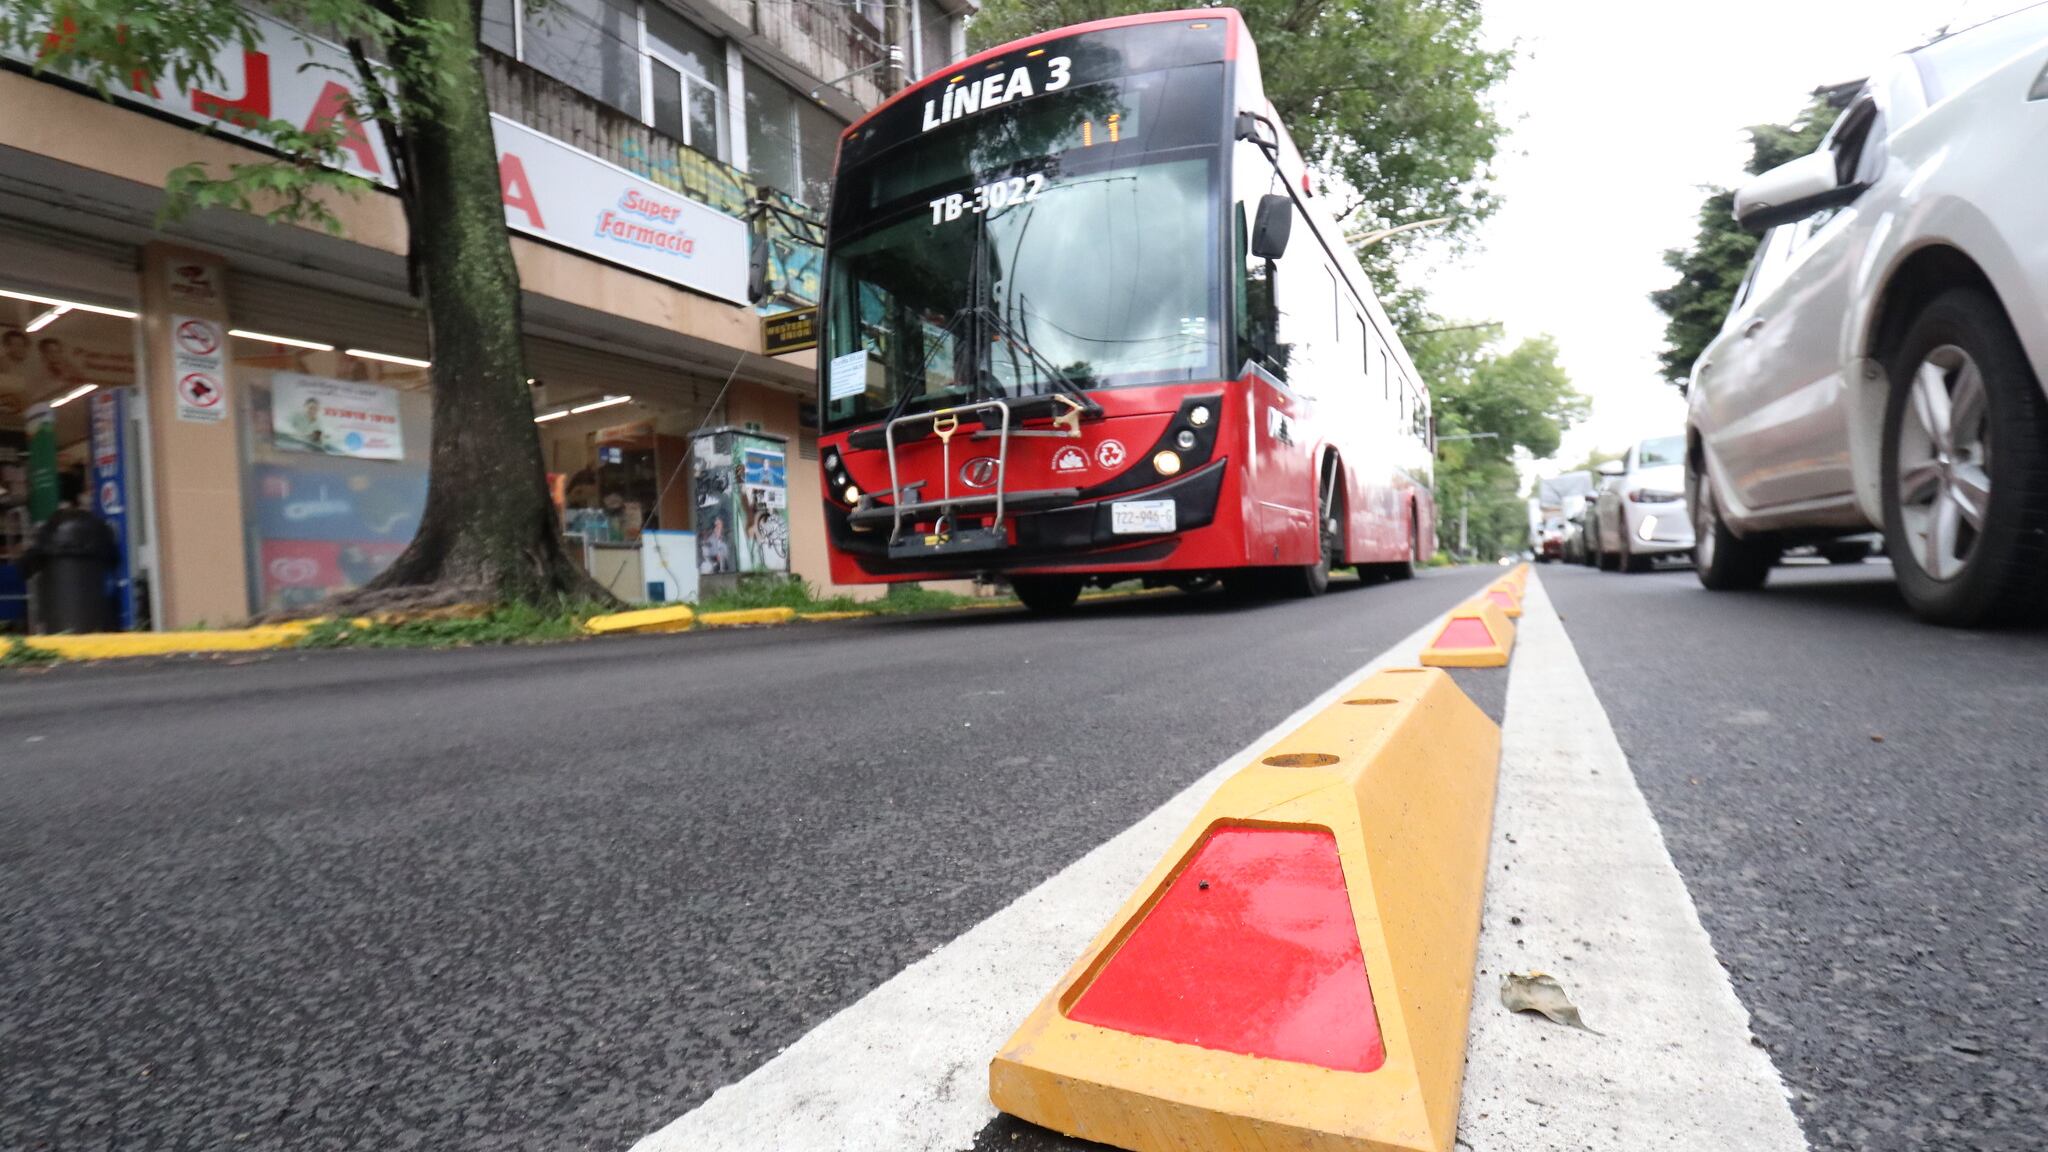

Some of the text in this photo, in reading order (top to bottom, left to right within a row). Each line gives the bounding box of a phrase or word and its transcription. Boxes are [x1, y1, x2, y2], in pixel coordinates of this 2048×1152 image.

[922, 66, 1034, 132] LÍNEA
[1045, 56, 1072, 91] 3
[621, 189, 682, 222] Super
[929, 173, 1044, 226] TB-3022
